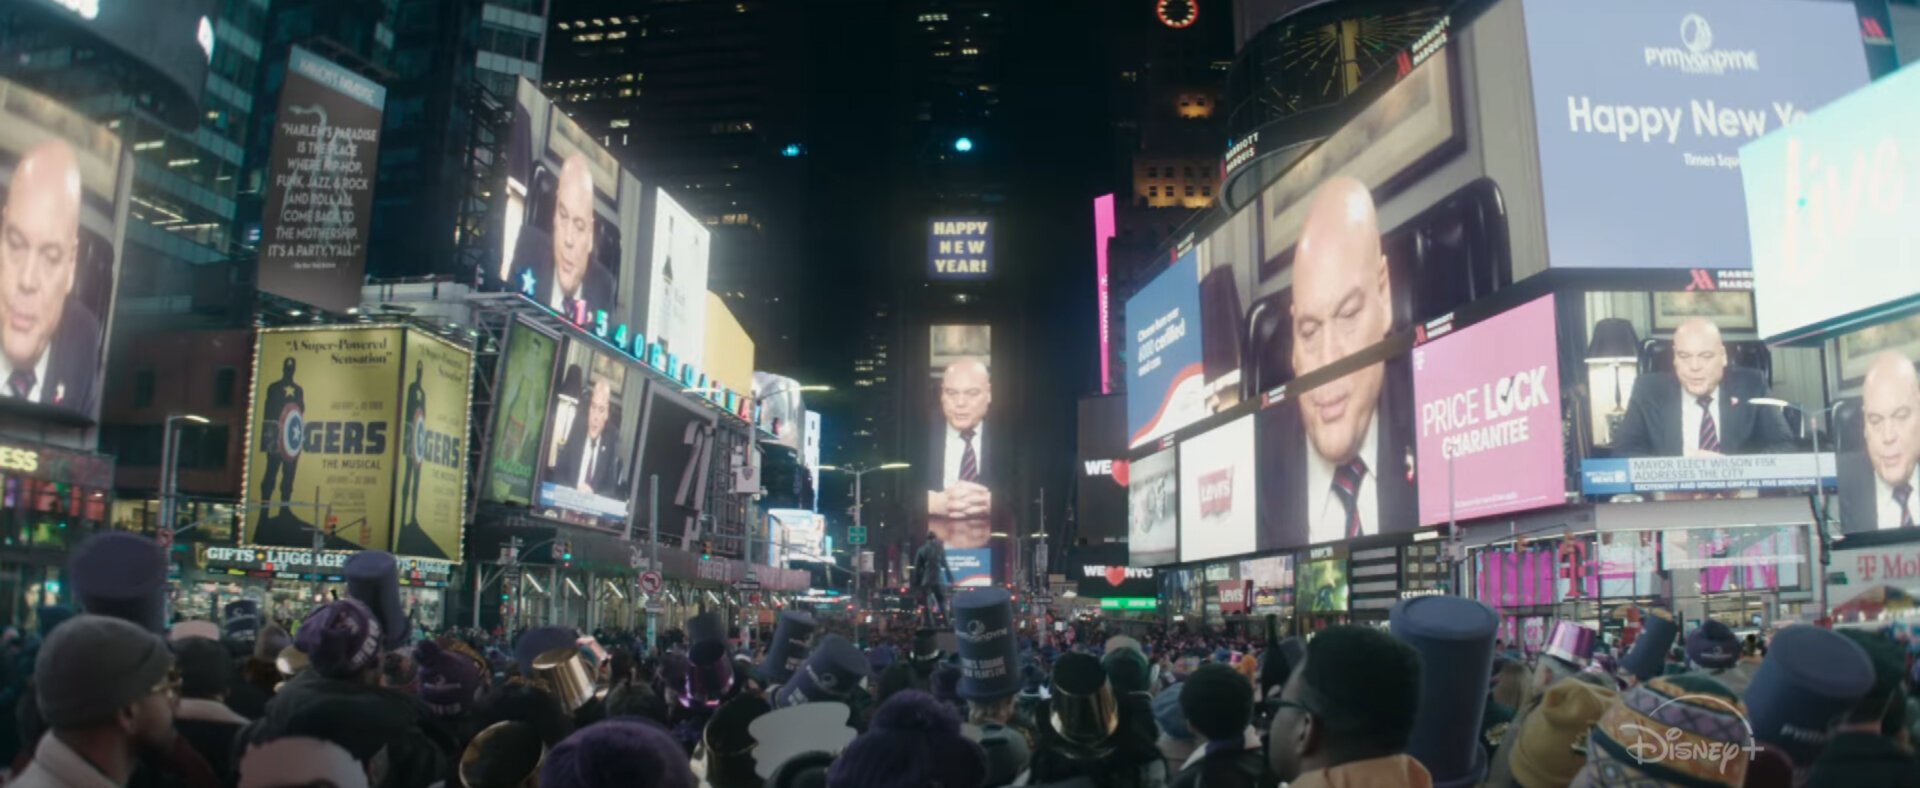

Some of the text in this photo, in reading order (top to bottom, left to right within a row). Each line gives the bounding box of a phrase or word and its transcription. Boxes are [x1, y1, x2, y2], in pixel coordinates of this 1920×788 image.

[1567, 96, 1682, 144] Happy
[1690, 99, 1766, 137] New
[334, 126, 377, 142] PARADISE
[1226, 131, 1259, 163] MARRIOTT
[1226, 147, 1255, 174] MARQUIS
[1683, 153, 1716, 169] Times
[342, 177, 368, 191] ROCK
[283, 209, 313, 223] COME
[276, 226, 295, 240] THE
[933, 222, 988, 235] HAPPY
[287, 245, 294, 257] A
[940, 240, 985, 254] NEW
[935, 260, 987, 273] YEAR!
[1422, 365, 1550, 438] PRICE LOCK
[1441, 415, 1530, 461] GUARANTEE
[322, 459, 382, 470] THE MUSICAL
[1084, 459, 1113, 476] WE
[1634, 460, 1675, 470] MAYOR
[1710, 458, 1753, 468] WILSON
[1755, 457, 1777, 467] FISK
[1634, 468, 1744, 481] ADDRESSES THE CITY
[207, 547, 348, 568] GIFTS LUGGAGE
[1083, 565, 1153, 579] WE NYC
